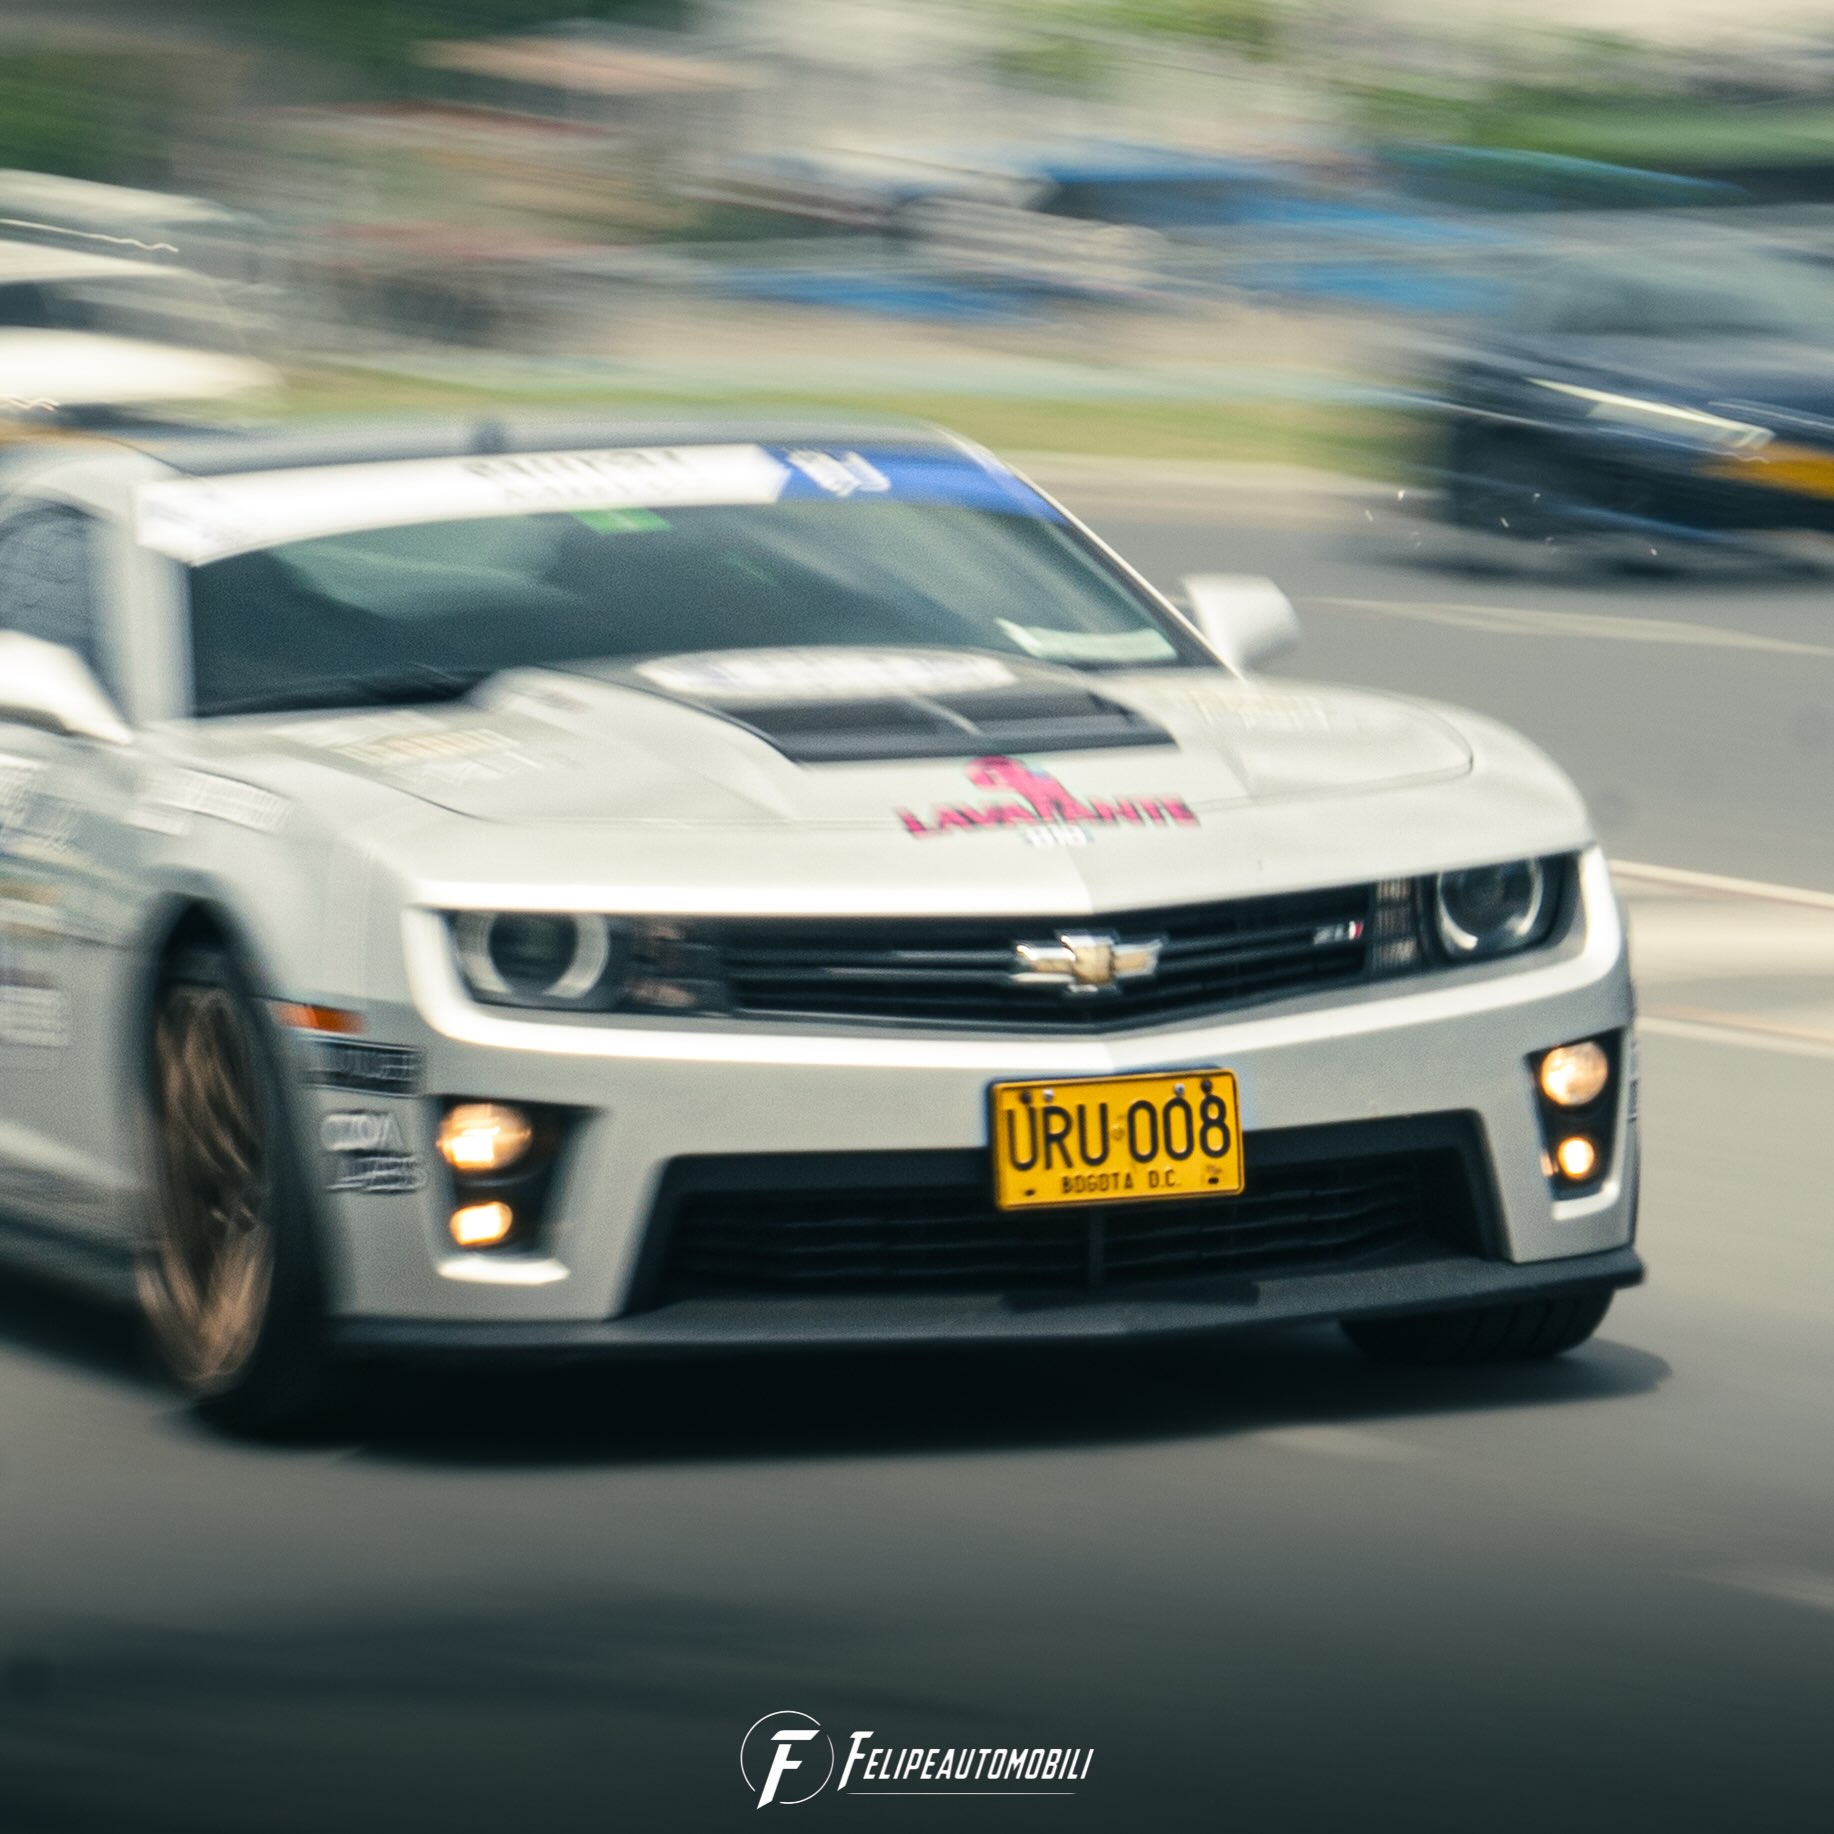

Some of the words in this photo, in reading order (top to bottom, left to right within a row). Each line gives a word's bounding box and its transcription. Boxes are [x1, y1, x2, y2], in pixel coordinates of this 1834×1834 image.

[1006, 1102, 1110, 1171] URU
[1126, 1094, 1231, 1164] 008
[1062, 1173, 1134, 1194] BOGOTA
